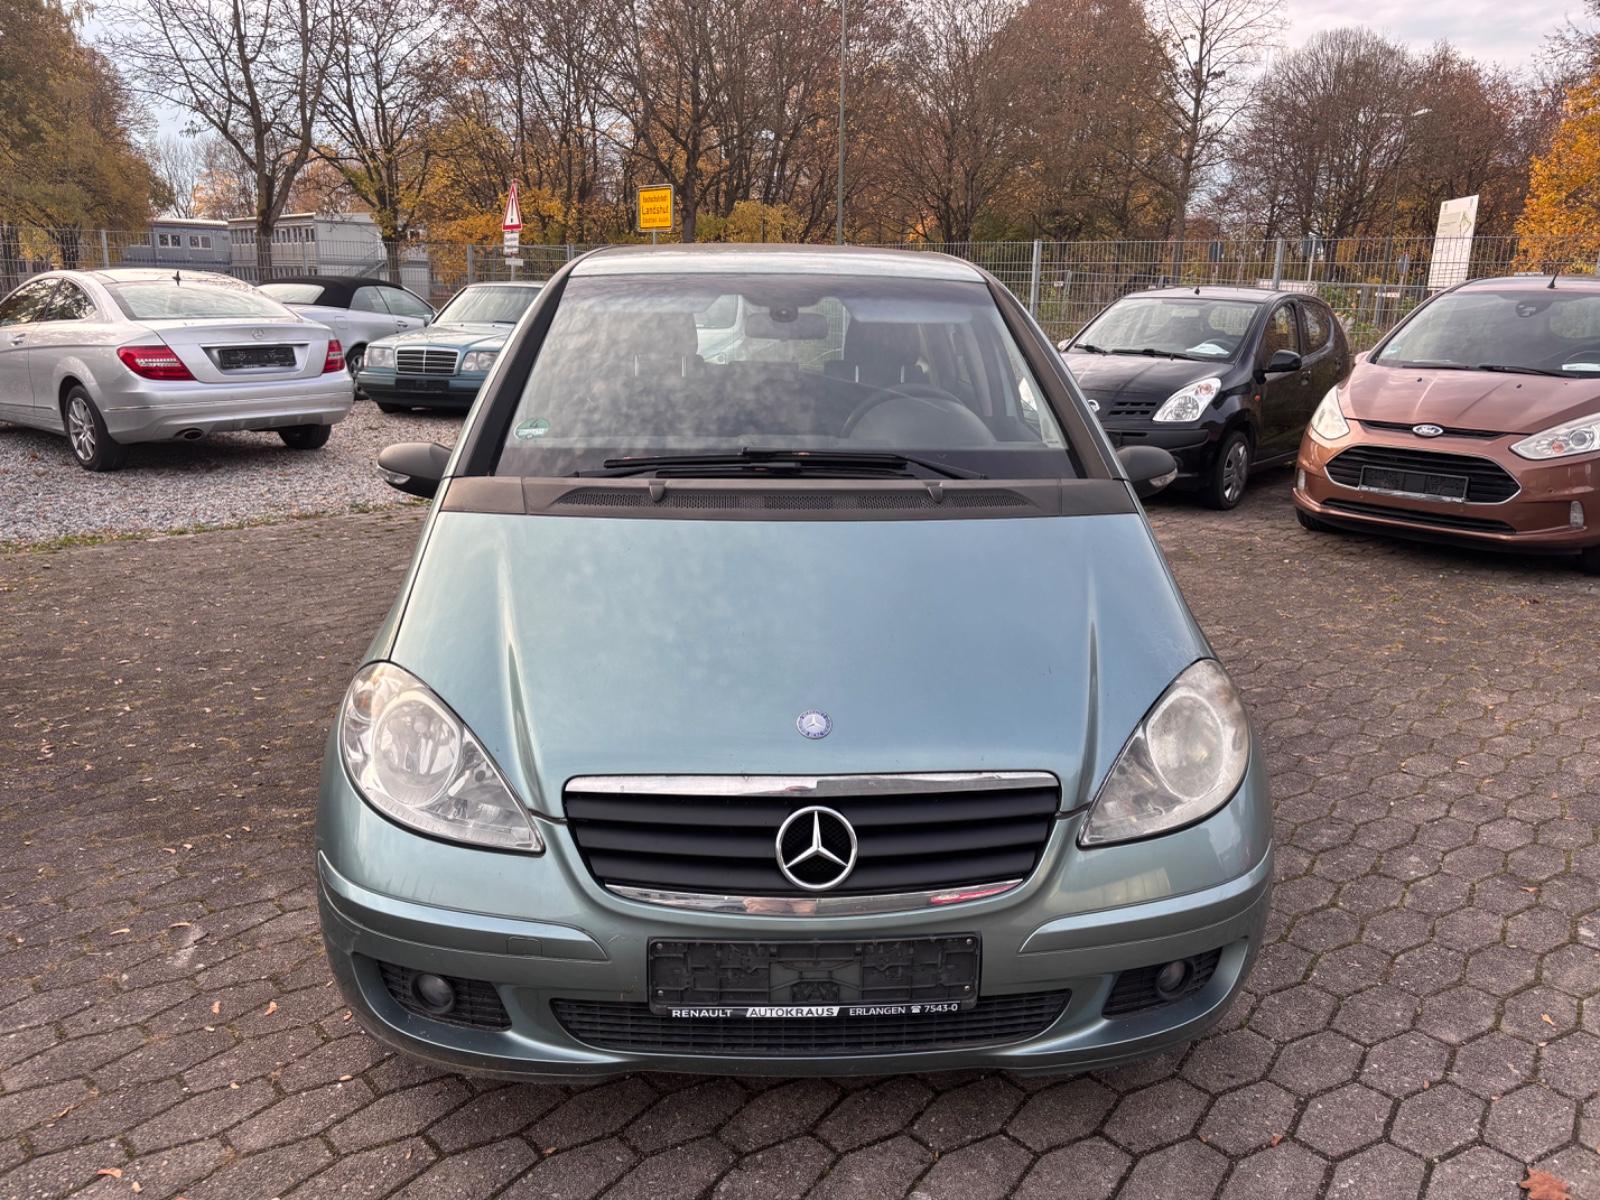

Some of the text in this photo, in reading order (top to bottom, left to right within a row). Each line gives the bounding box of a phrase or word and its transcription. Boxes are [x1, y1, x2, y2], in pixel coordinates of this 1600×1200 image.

[671, 1003, 958, 1018] RENAULT AUTOKRAUS ERLANGEN 7543-0
